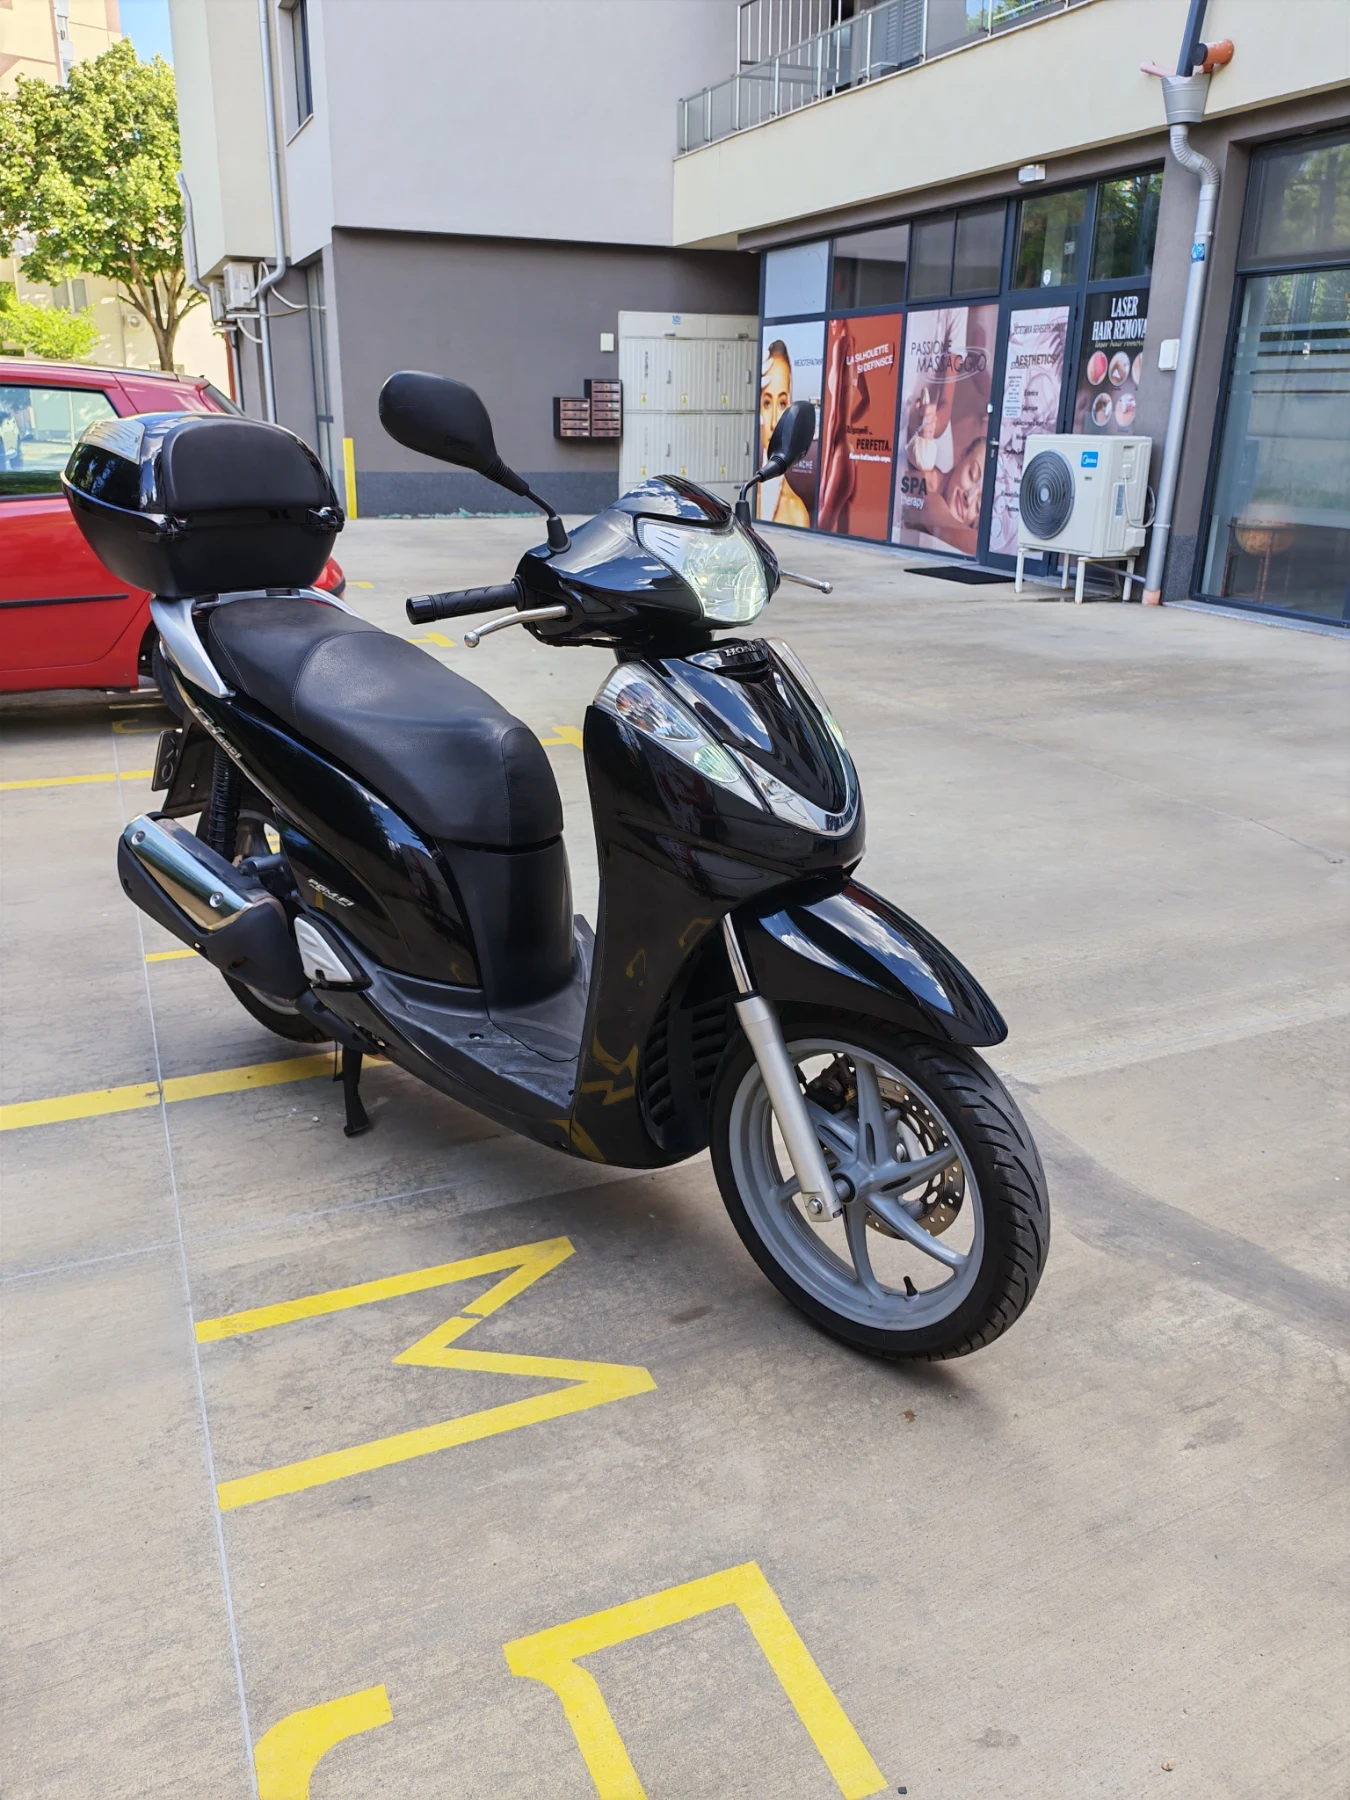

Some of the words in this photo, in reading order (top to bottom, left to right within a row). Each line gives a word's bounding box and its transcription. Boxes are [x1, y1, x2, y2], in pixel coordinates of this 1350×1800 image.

[1111, 295, 1139, 317] LASER
[1092, 320, 1113, 340] HAIR
[1113, 318, 1148, 340] REMOVA
[911, 340, 953, 355] PASSIONE
[846, 355, 855, 366] LA
[916, 353, 987, 373] MASSAGGIO
[1015, 353, 1057, 367] AESTHETICS
[901, 476, 928, 496] SPA
[901, 494, 925, 510] therapy
[723, 644, 758, 657] HOND
